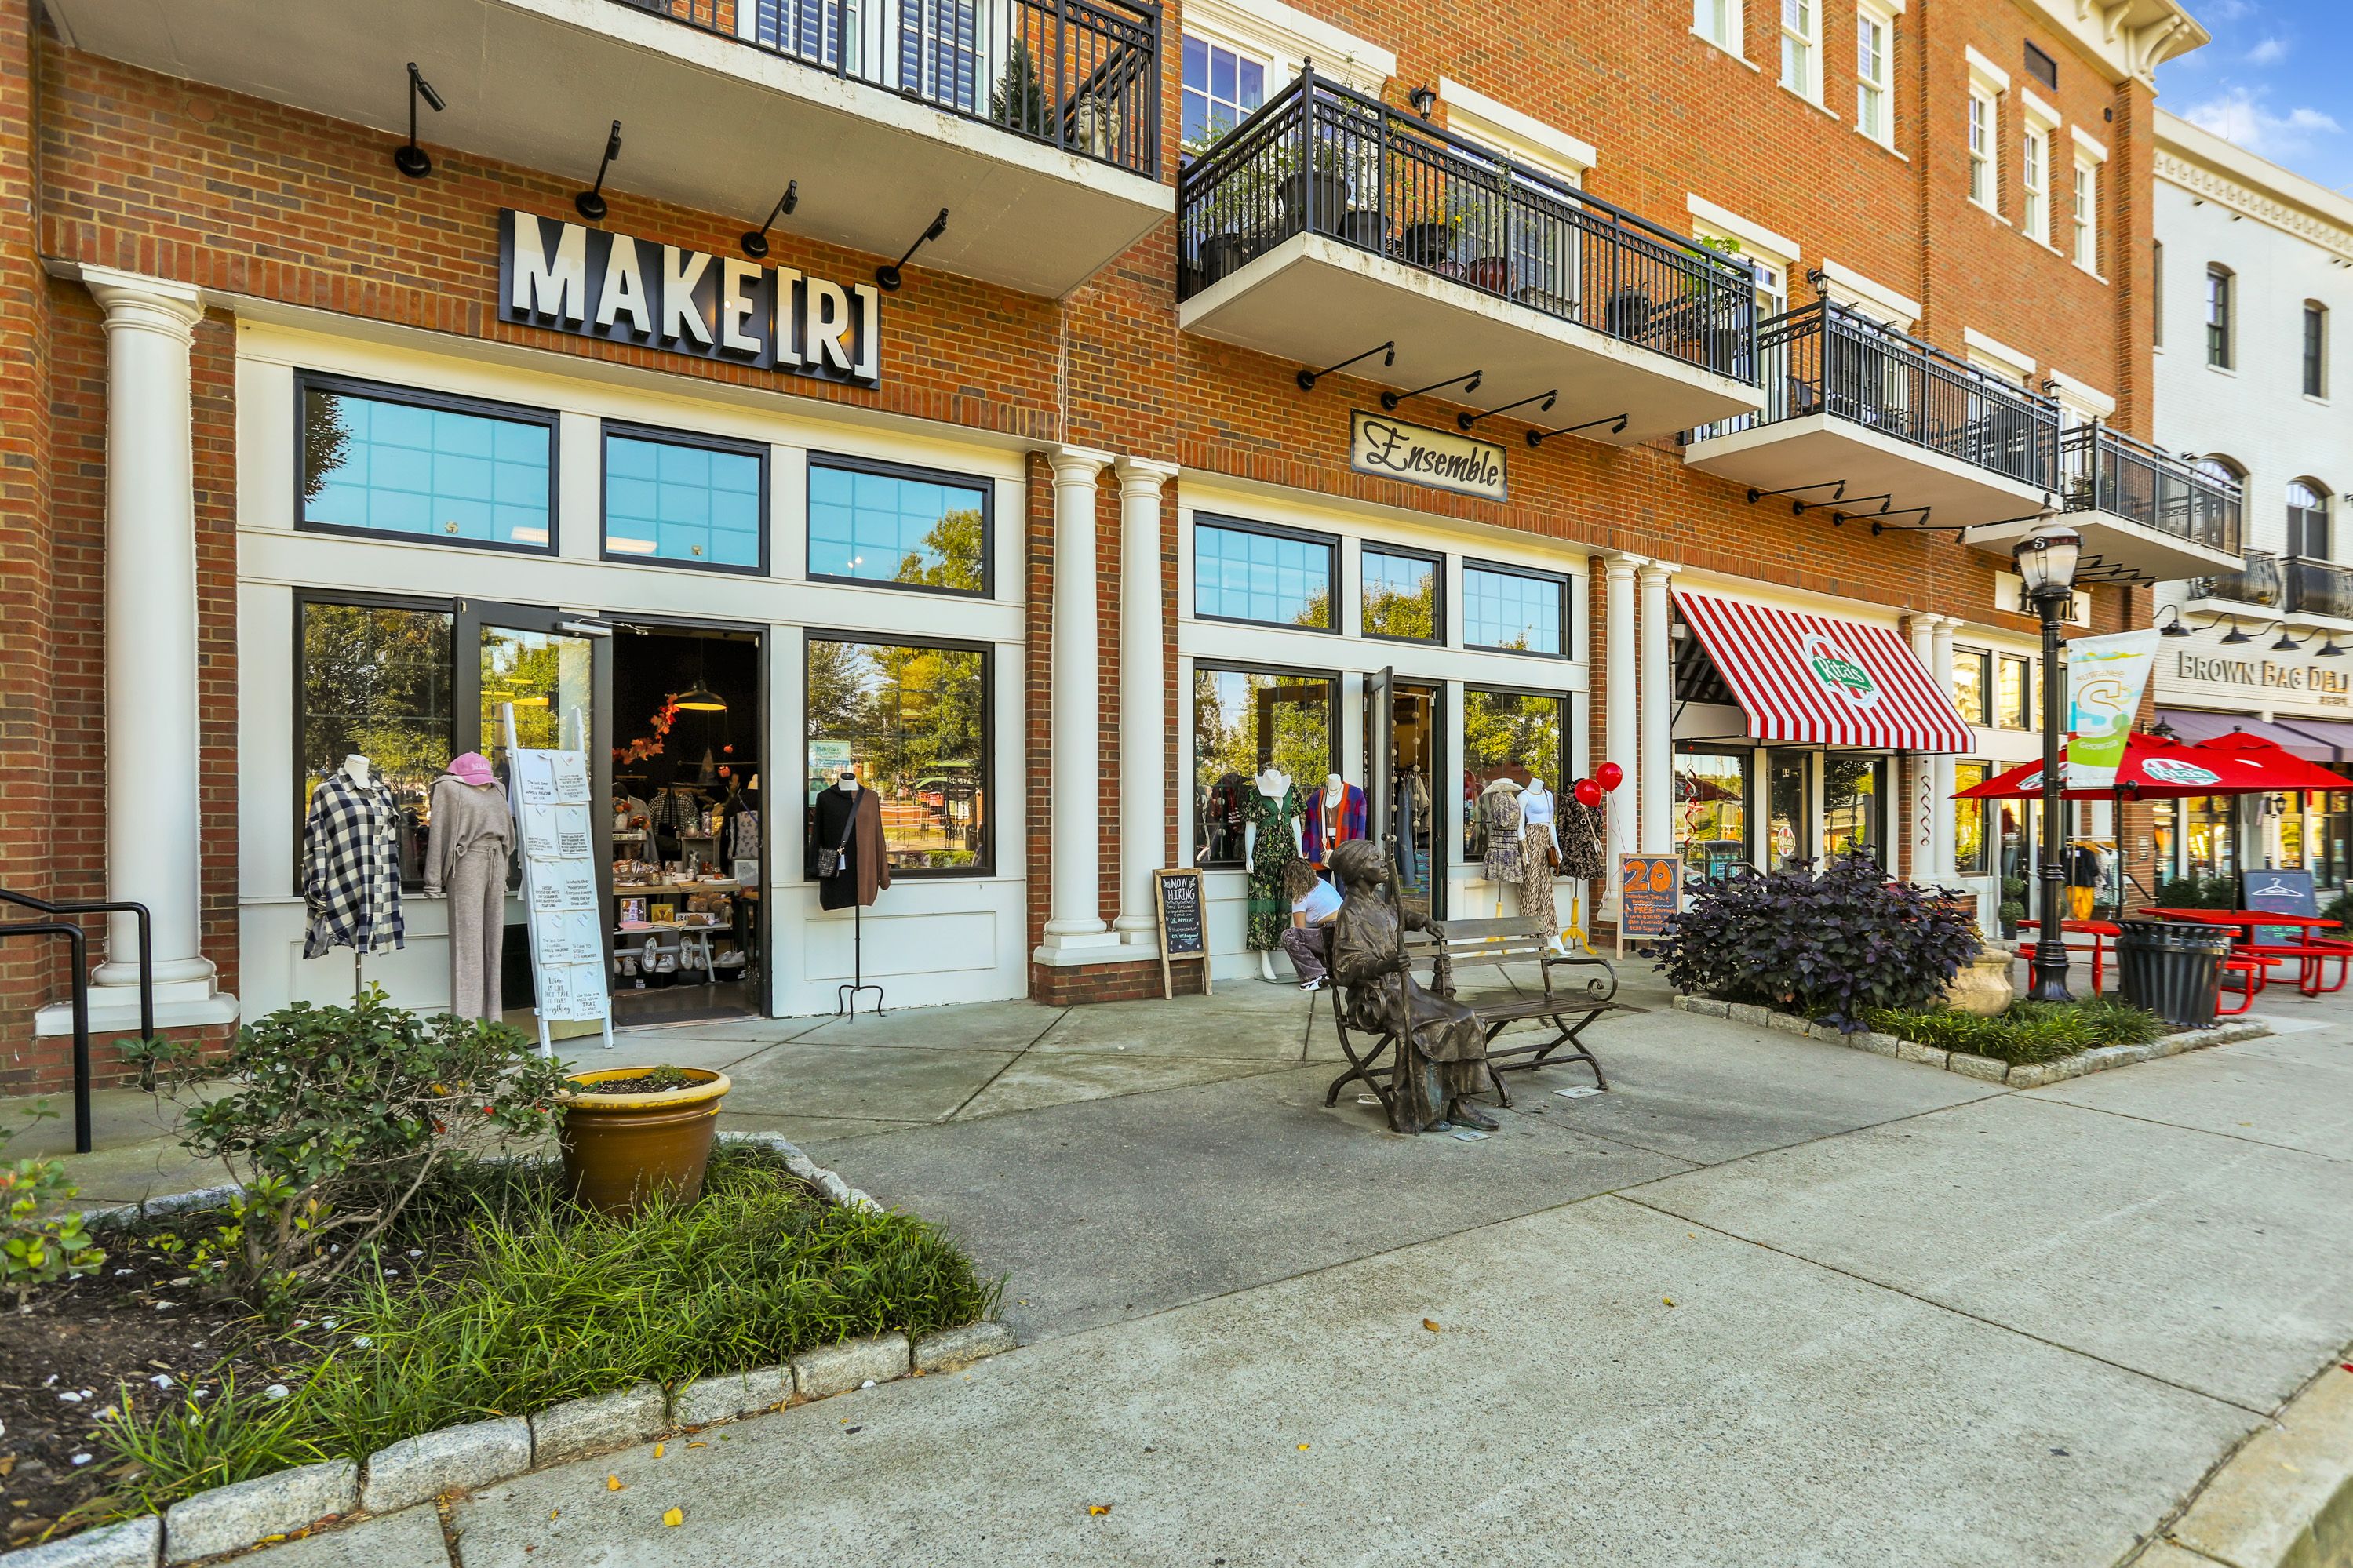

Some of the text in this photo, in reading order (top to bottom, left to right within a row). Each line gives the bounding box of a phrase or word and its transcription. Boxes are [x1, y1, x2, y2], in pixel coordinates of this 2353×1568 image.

[512, 209, 879, 382] MAKE[R]
[1363, 420, 1499, 486] Ensemble
[1813, 653, 1865, 683] Rita's
[2178, 650, 2348, 694] BROWN BAG DELI
[1171, 878, 1187, 889] NOW
[1624, 859, 1674, 893] 20
[1167, 887, 1195, 901] HIRING
